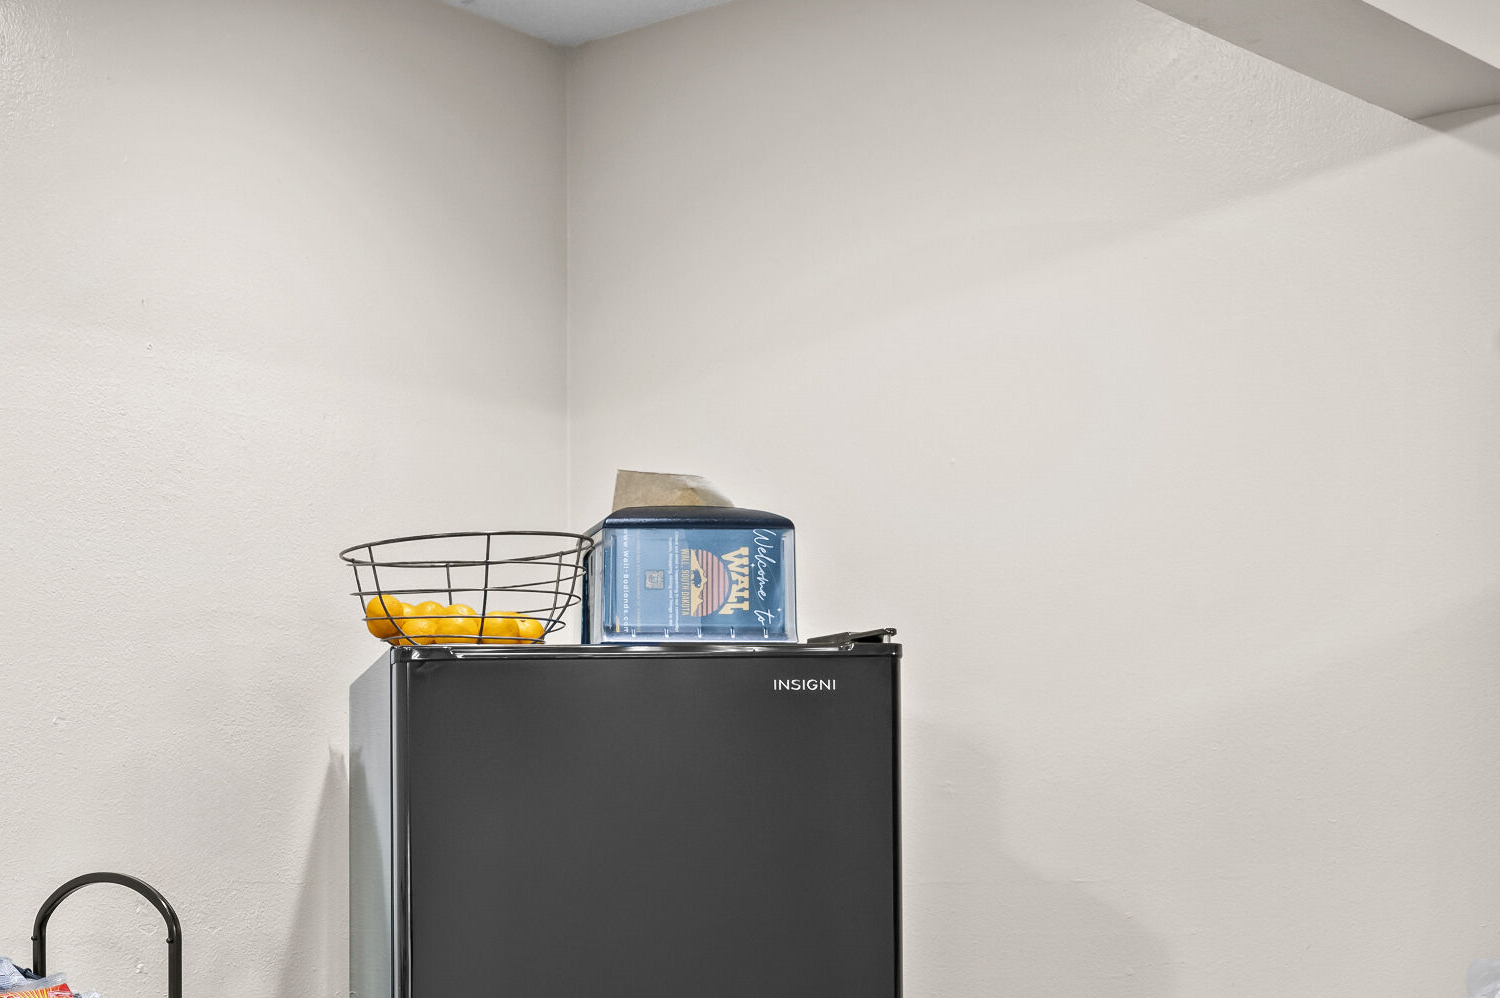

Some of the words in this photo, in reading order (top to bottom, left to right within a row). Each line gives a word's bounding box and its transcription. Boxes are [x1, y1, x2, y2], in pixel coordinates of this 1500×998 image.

[752, 529, 777, 600] Welcome
[680, 570, 691, 590] SOUTH
[718, 546, 750, 615] WALL
[680, 591, 691, 615] DAKOTA
[753, 608, 776, 626] to
[773, 679, 836, 691] INSIGNI
